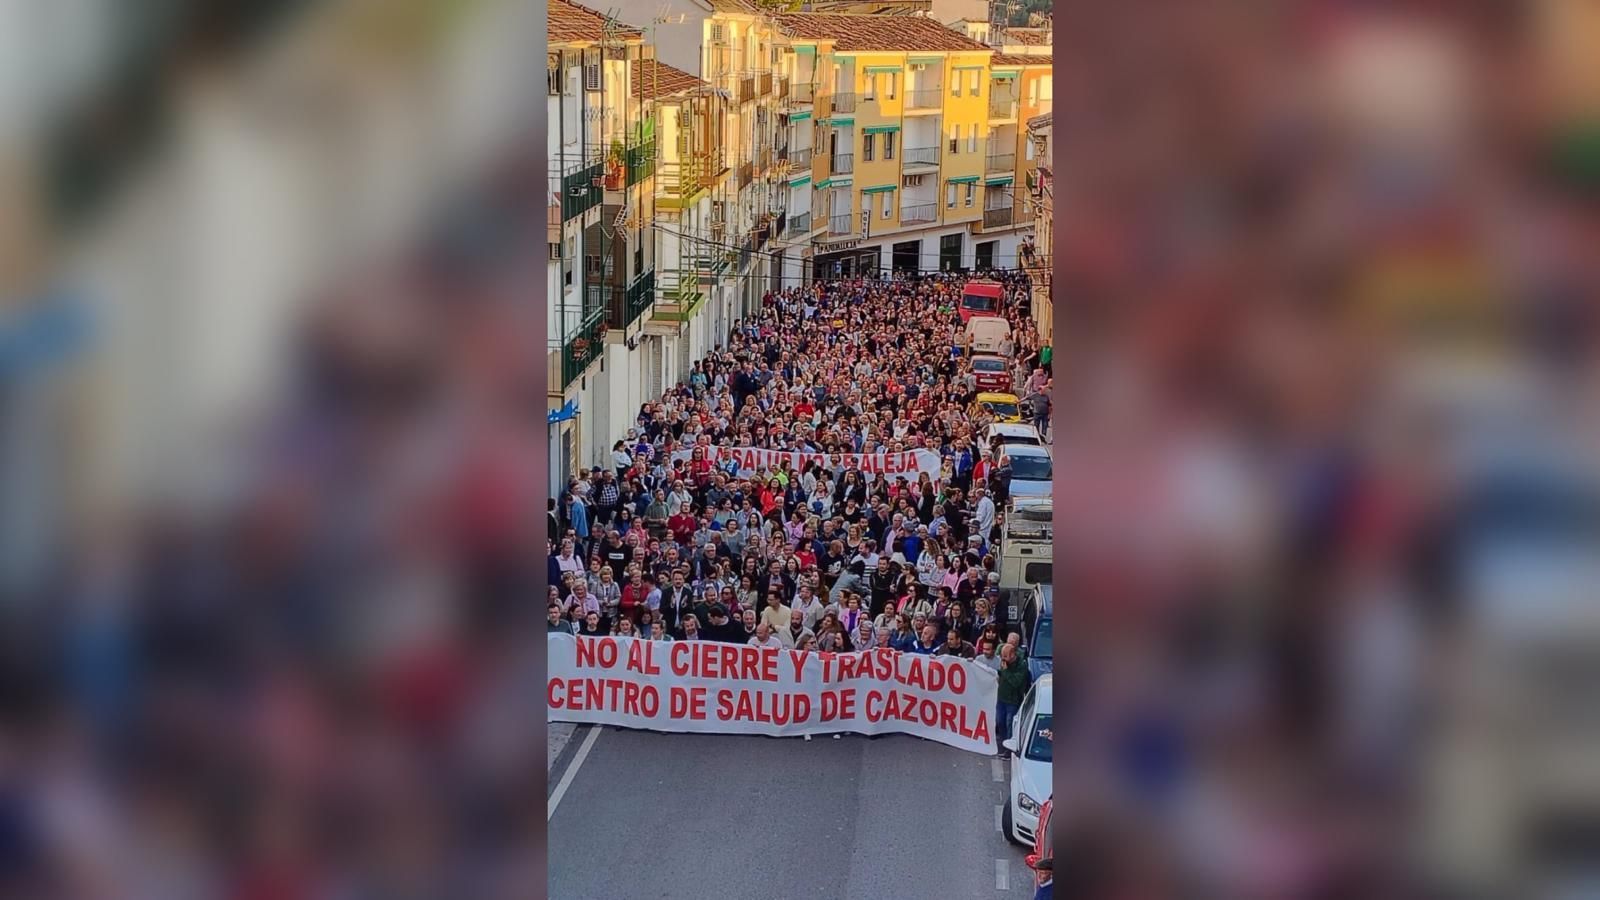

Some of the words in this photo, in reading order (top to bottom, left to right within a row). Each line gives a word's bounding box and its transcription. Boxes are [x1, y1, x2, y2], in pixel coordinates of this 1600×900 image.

[860, 450, 919, 474] ALEJA
[576, 635, 618, 669] NO
[626, 639, 661, 675] AL
[670, 642, 779, 682] CIERRE
[789, 650, 809, 683] Y
[818, 647, 967, 695] TRASLADO
[547, 677, 660, 718] CENTRO
[670, 687, 707, 720] DE
[716, 689, 811, 726] SALUD
[820, 688, 857, 723] DE
[865, 690, 990, 745] CAZORLA
